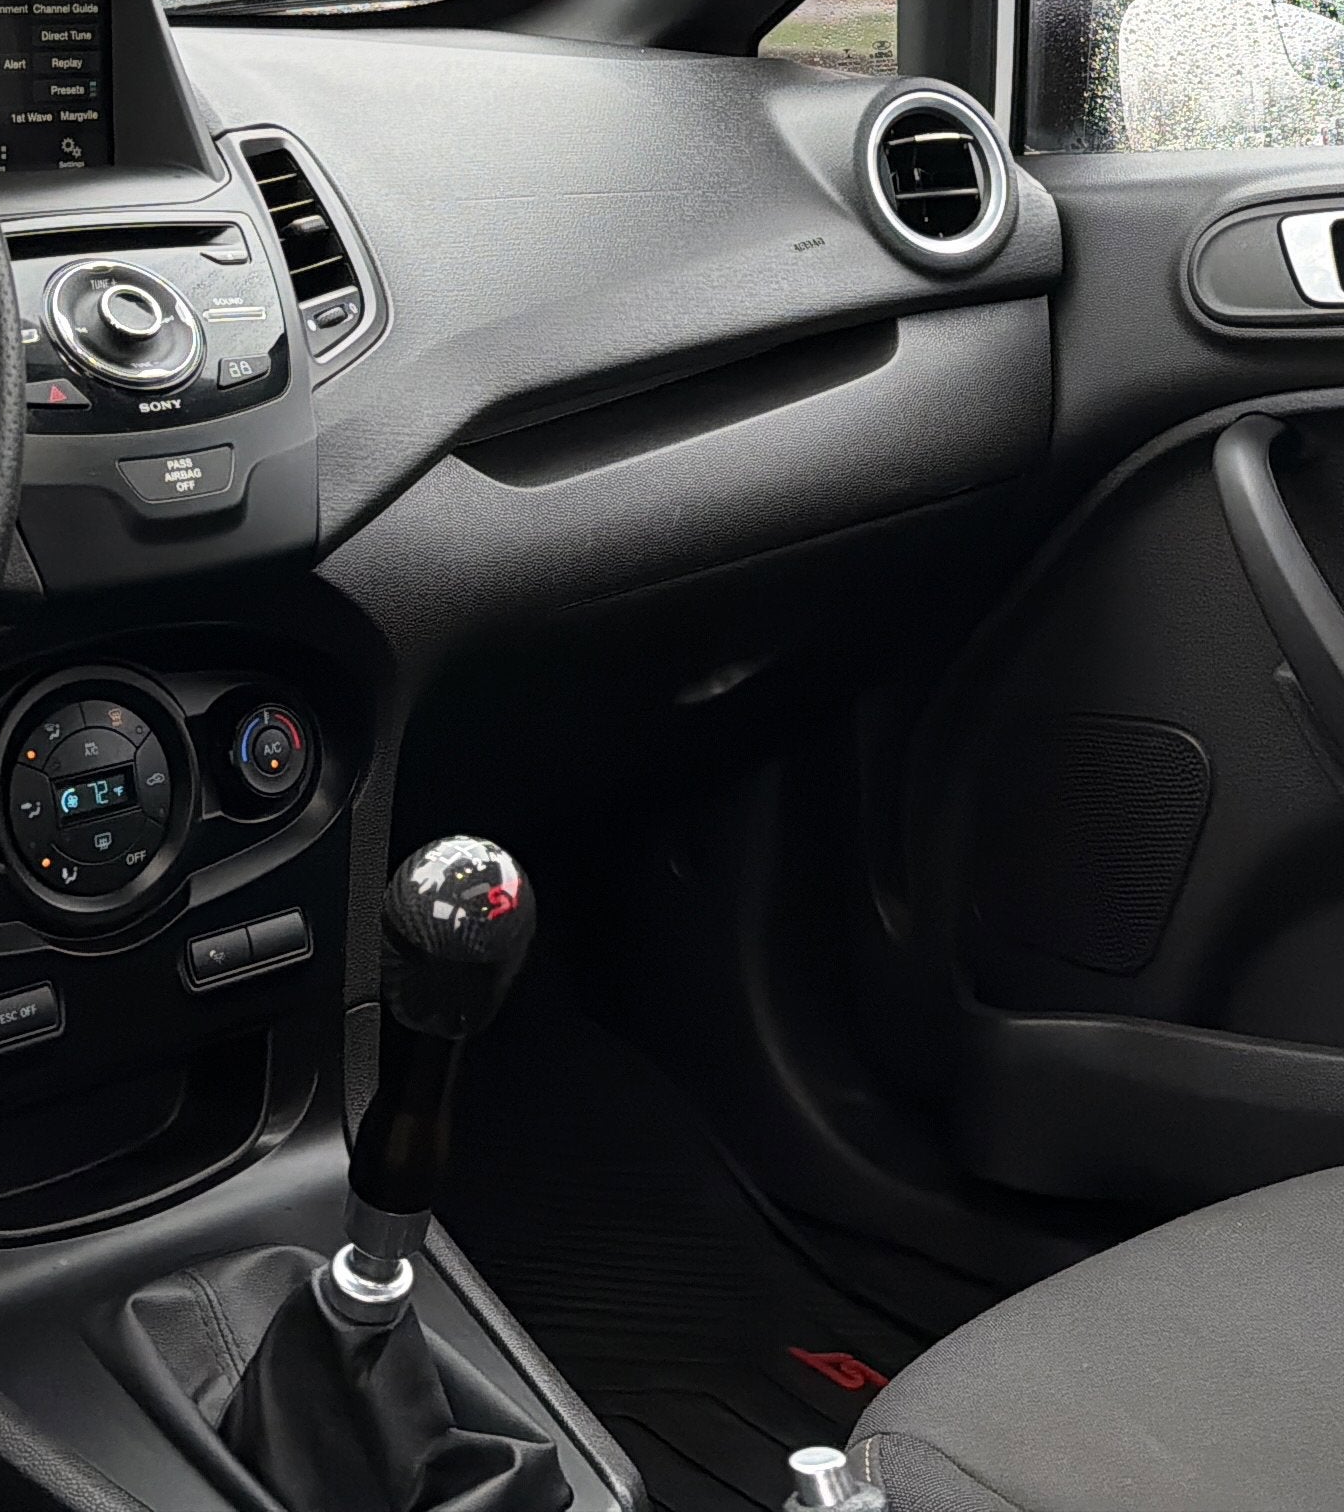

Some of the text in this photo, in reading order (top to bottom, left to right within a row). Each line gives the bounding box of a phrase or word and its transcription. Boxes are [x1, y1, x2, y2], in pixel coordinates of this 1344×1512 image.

[32, 3, 99, 14] Channel Guide
[41, 30, 92, 42] Direct Tune
[3, 57, 27, 69] Alert
[51, 58, 83, 69] Replay
[50, 85, 85, 95] Presets
[10, 112, 53, 123] 1st Wave
[213, 297, 244, 305] SOUND
[138, 399, 182, 414] SONY
[167, 458, 193, 470] PASS
[164, 468, 202, 482] AIRBAG
[176, 480, 196, 492] OFF
[263, 741, 282, 756] A/C
[87, 780, 109, 806] 72
[126, 850, 147, 866] OFF
[0, 1003, 38, 1025] ESC OFF
